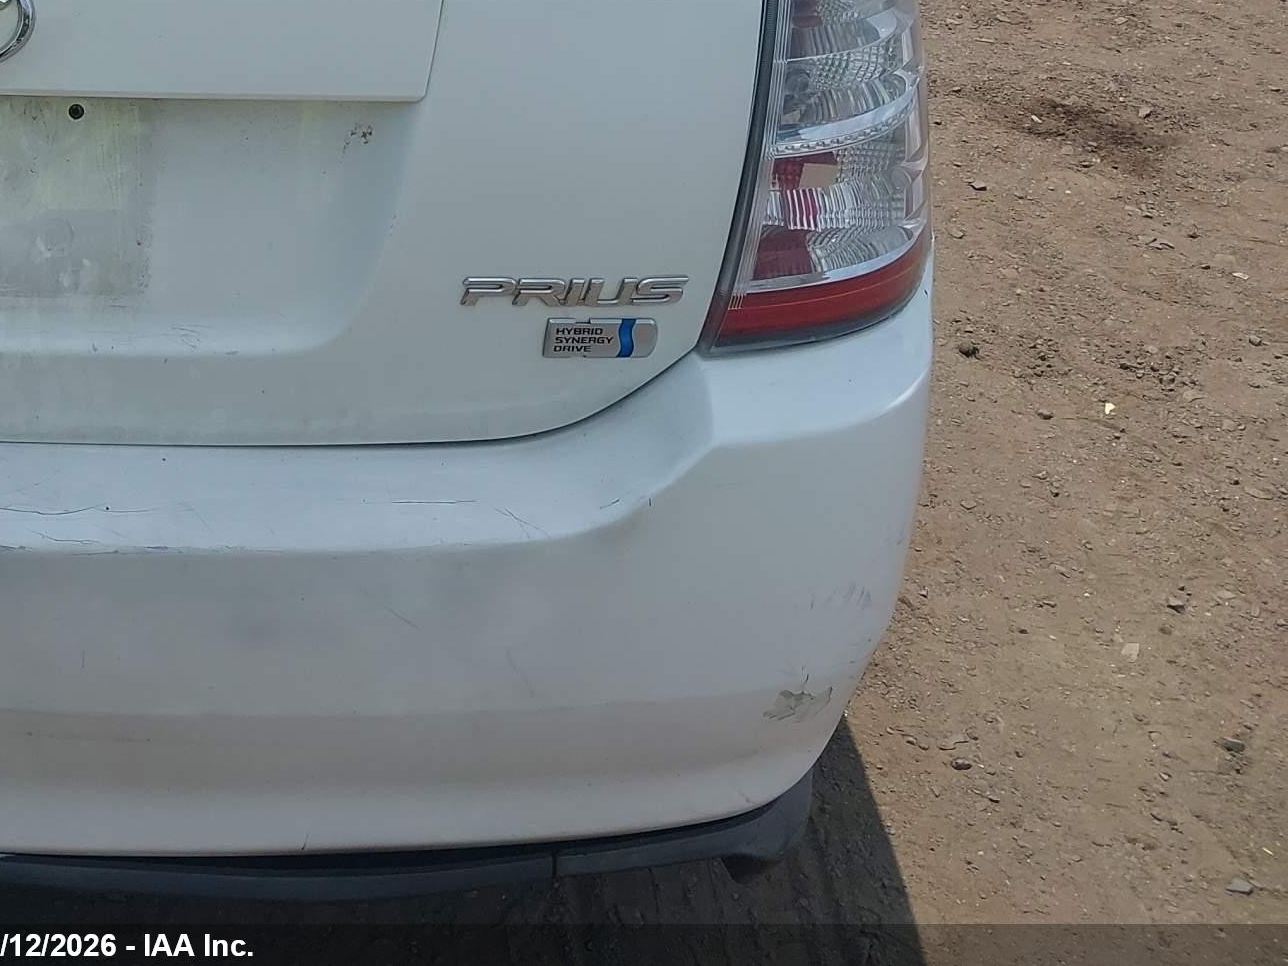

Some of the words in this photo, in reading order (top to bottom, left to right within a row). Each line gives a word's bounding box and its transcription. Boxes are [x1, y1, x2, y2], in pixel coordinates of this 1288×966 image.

[460, 274, 689, 308] PRIUS
[554, 327, 604, 336] HYBRID
[554, 336, 615, 345] SYNERGY
[552, 345, 592, 353] DRIVE
